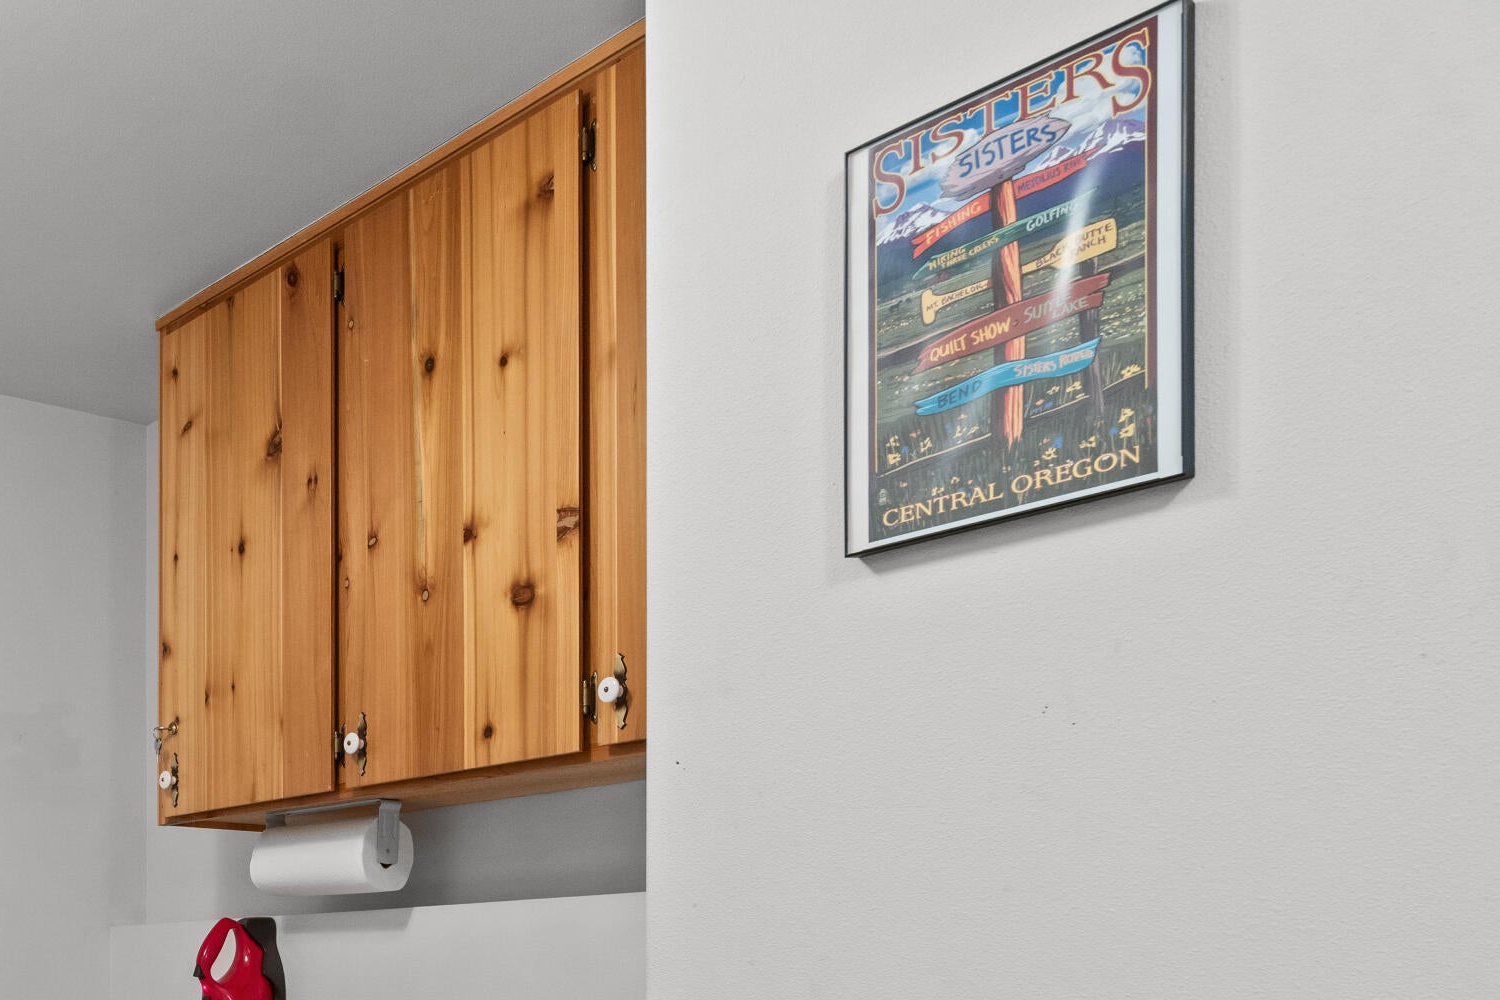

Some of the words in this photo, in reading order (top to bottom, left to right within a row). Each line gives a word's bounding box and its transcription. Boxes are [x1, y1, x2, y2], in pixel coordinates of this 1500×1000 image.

[873, 26, 1152, 218] SISTERS
[958, 124, 1057, 178] SISTERS
[925, 201, 981, 245] FISHING
[1081, 222, 1113, 241] UTTE
[928, 247, 967, 271] HIKING
[1075, 235, 1106, 257] ANCH
[1052, 296, 1089, 319] LAKE
[928, 334, 967, 362] QUILT
[971, 317, 1011, 345] SHOW
[1013, 361, 1057, 378] SISTERS
[936, 380, 983, 408] BEND
[882, 482, 1004, 527] CENTRAL
[1011, 445, 1141, 494] OREGON
